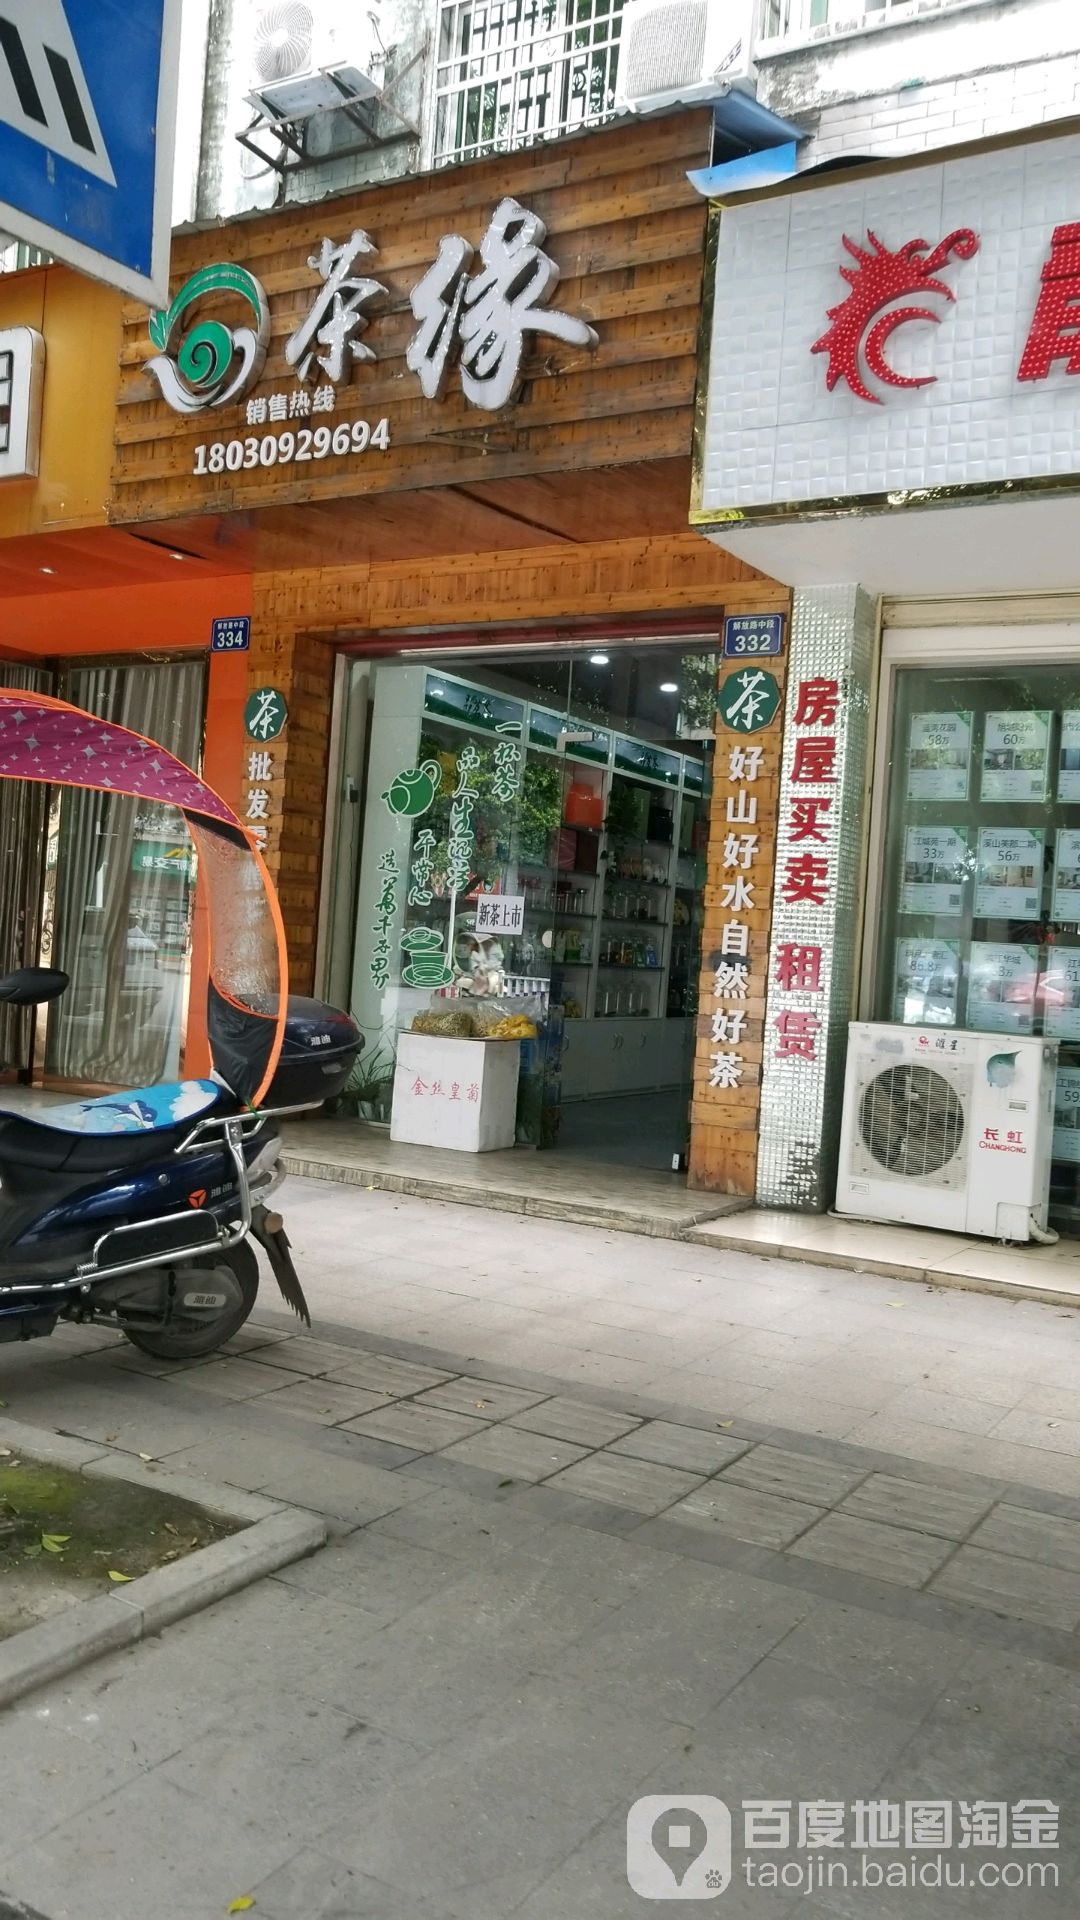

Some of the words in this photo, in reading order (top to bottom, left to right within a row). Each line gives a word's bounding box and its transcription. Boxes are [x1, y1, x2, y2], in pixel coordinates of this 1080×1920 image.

[285, 197, 598, 411] 茶缘
[246, 384, 336, 424] 销售热线
[193, 419, 390, 475] 18030929694
[217, 630, 244, 648] 334
[733, 620, 775, 631] 解放路中段
[735, 634, 772, 653] 332
[726, 671, 770, 730] 茶
[249, 690, 279, 740] 茶
[923, 847, 945, 859] 33万
[998, 850, 1021, 862] 56万
[772, 676, 840, 1062] 房屋买卖租赁
[479, 902, 522, 929] 新茶上市
[708, 745, 765, 1089] 好山好水自然好茶
[978, 1140, 1027, 1154] CHANGHONG
[984, 1127, 1024, 1144] 长虹
